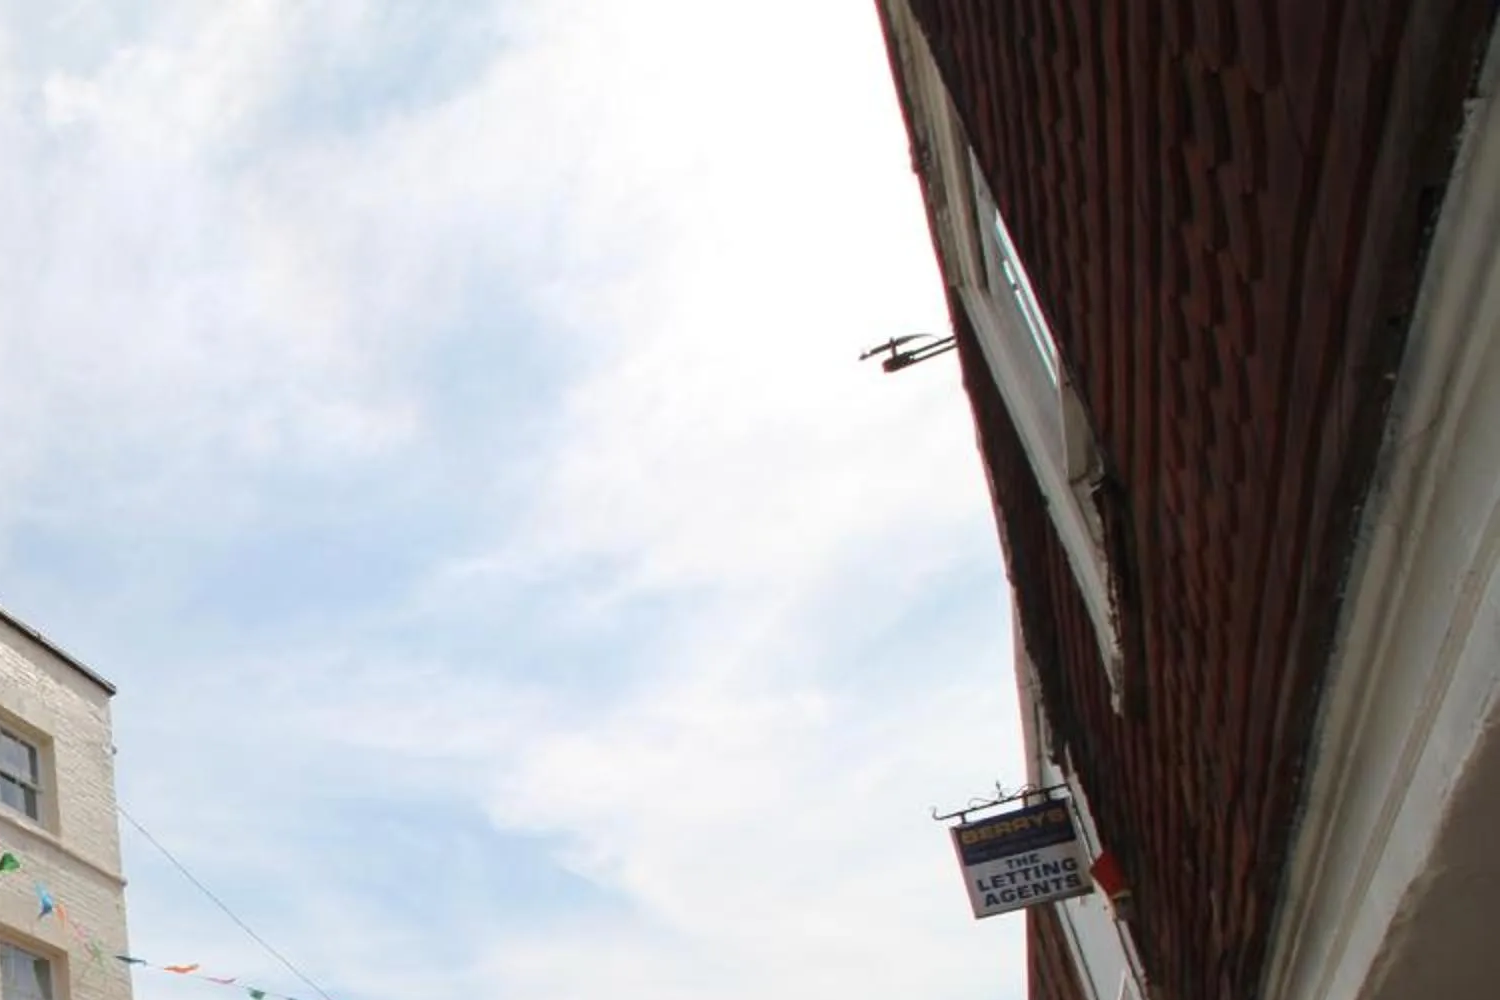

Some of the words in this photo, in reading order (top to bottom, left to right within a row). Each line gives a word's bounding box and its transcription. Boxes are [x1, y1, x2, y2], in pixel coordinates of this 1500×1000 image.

[977, 858, 1078, 892] LETTING
[1007, 853, 1040, 869] THE
[985, 873, 1082, 907] AGENTS
